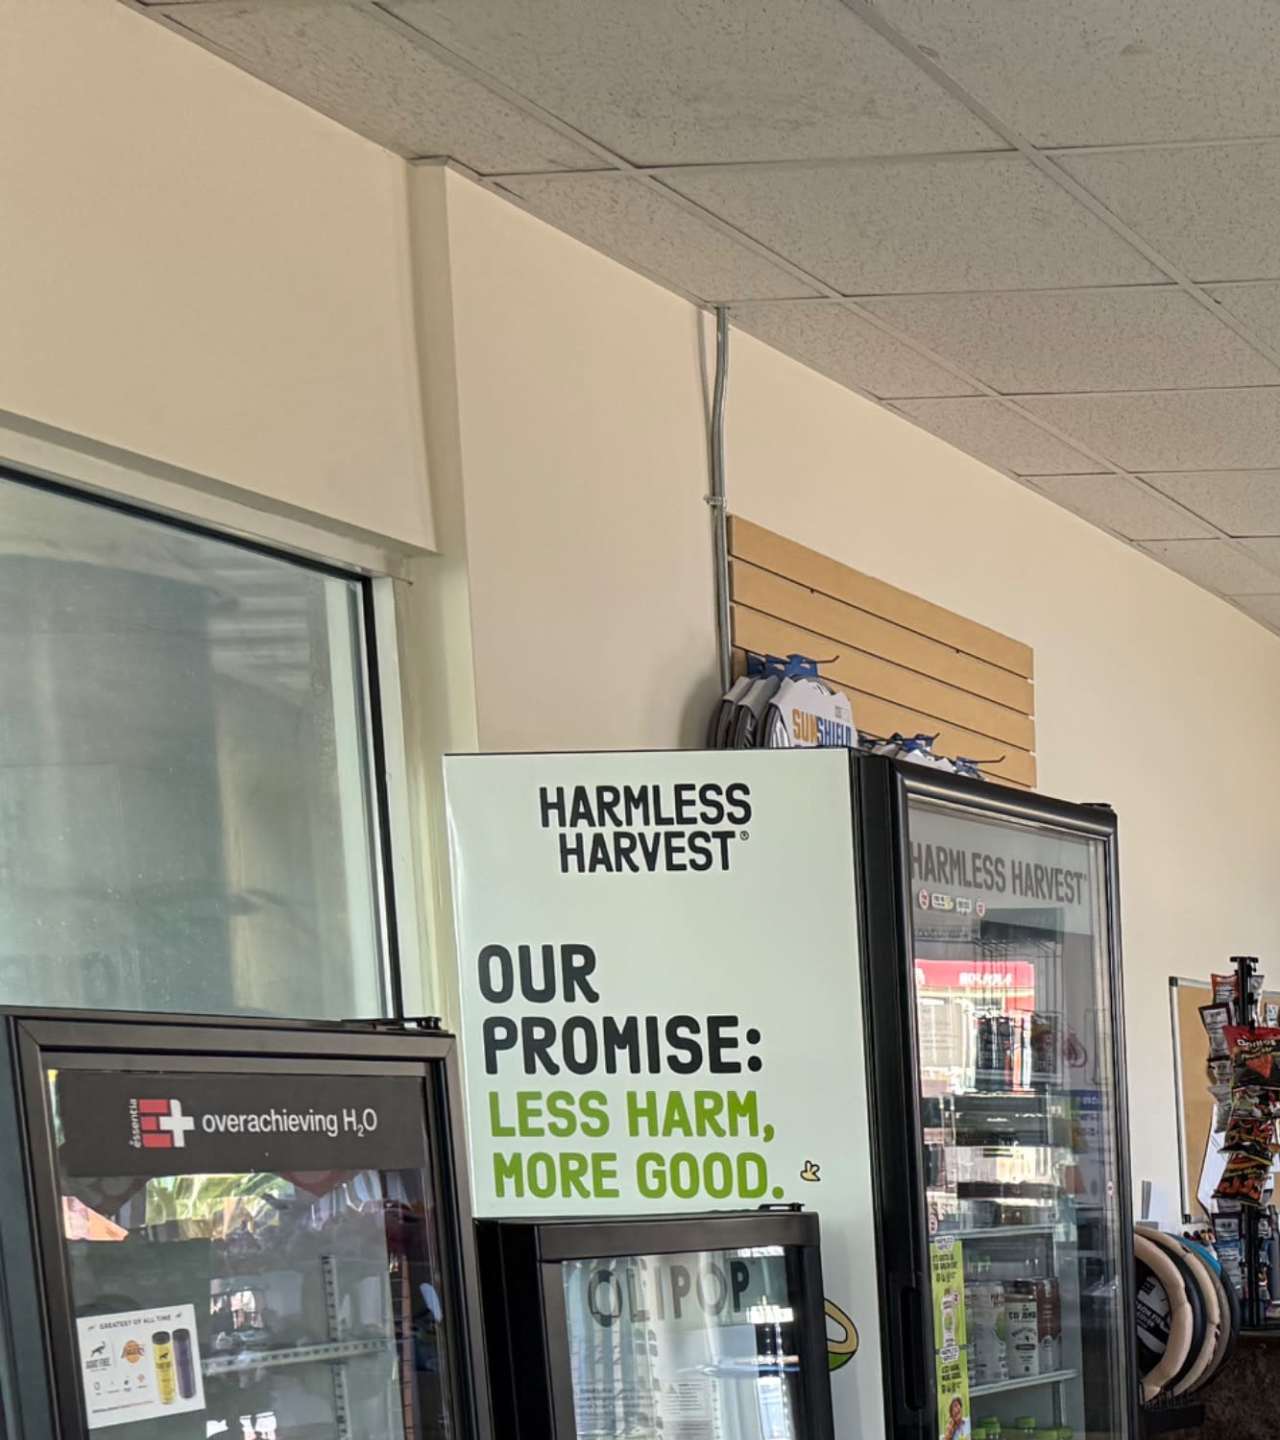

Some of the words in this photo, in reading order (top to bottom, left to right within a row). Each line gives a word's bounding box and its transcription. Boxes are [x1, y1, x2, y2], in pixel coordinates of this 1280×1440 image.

[539, 783, 753, 828] HARMLESS
[910, 842, 1007, 893] HARMLESS
[477, 944, 600, 1004] OUR
[482, 1015, 763, 1075] PROMISE:
[202, 1109, 339, 1137] overachieving
[488, 1090, 611, 1138] LESS
[626, 1090, 775, 1142] HARM,
[493, 1152, 620, 1198] MORE
[636, 1152, 785, 1199] GOOD.
[587, 1260, 751, 1328] OLIPOP
